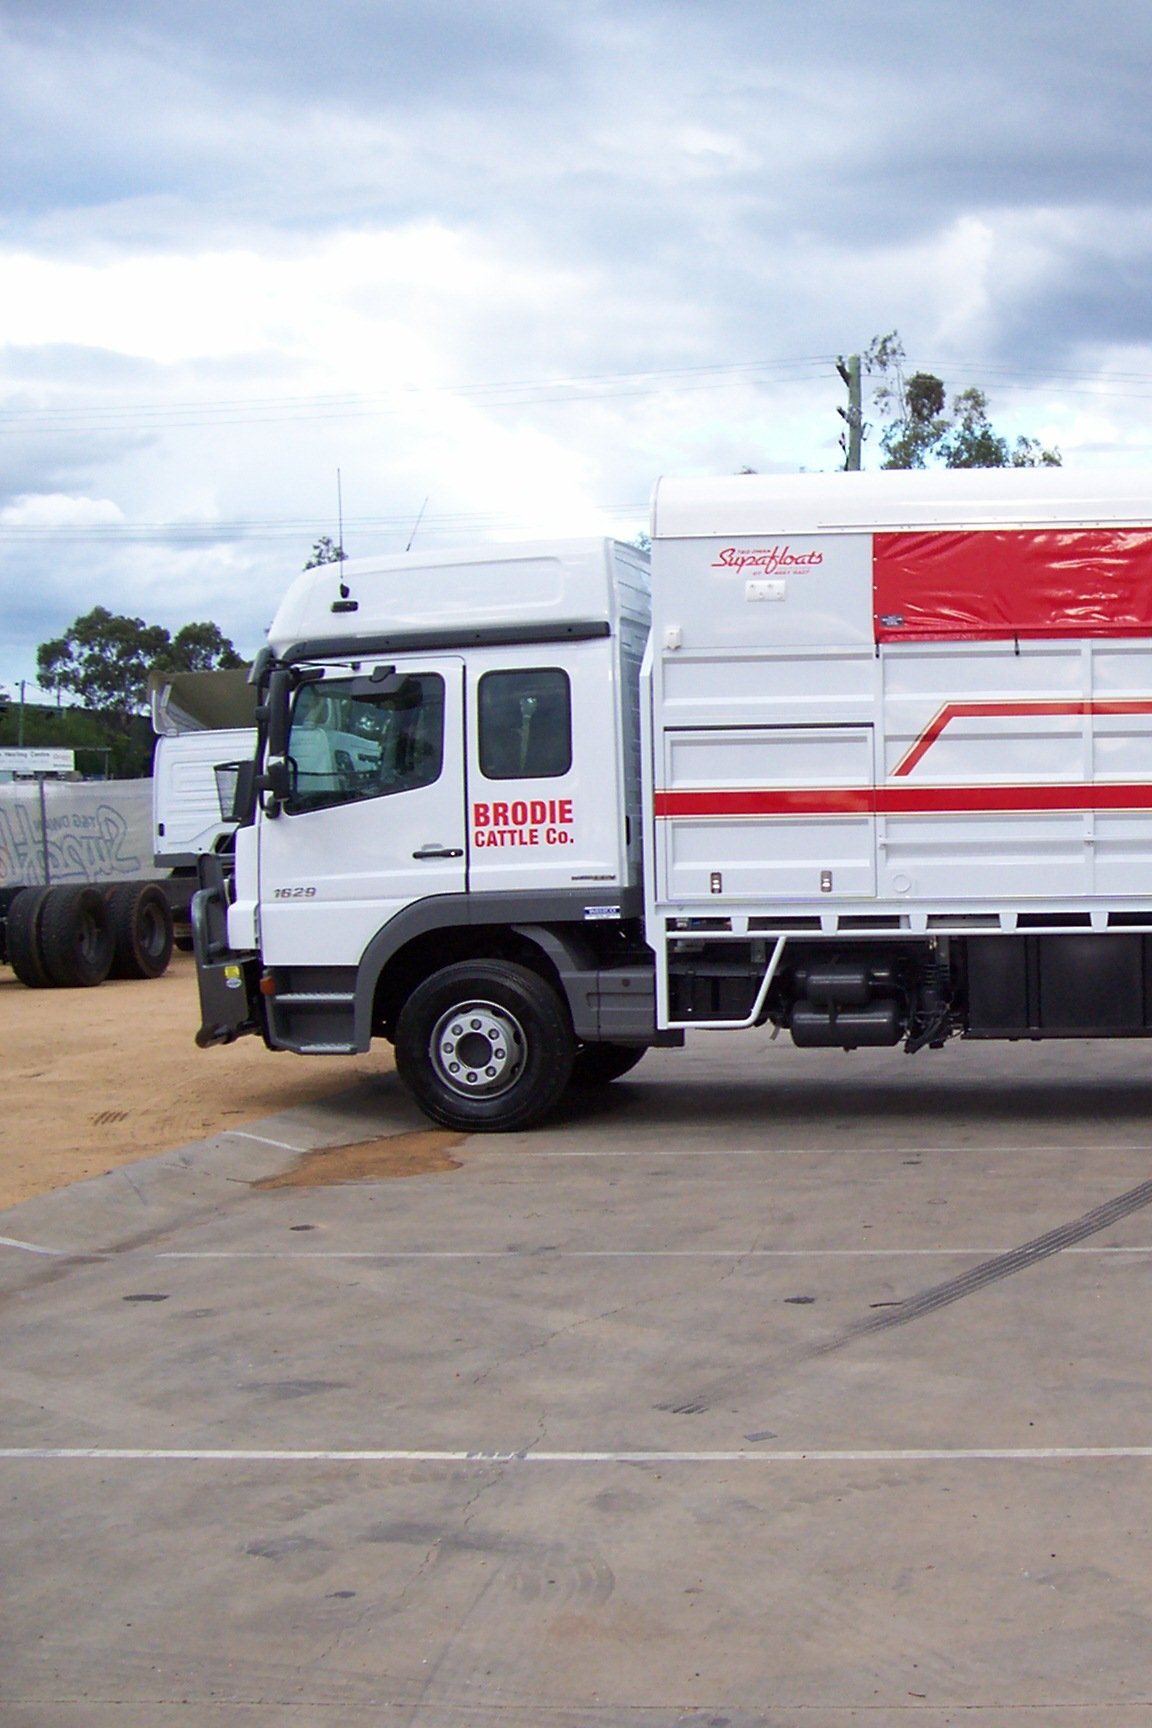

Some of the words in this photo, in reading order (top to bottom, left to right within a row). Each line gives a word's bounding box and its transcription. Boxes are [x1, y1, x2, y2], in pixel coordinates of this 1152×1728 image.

[711, 546, 823, 574] Supafloats
[474, 800, 573, 827] BRODIE
[475, 829, 539, 848] CATTLE
[546, 827, 574, 845] Co.
[273, 887, 317, 899] 1629
